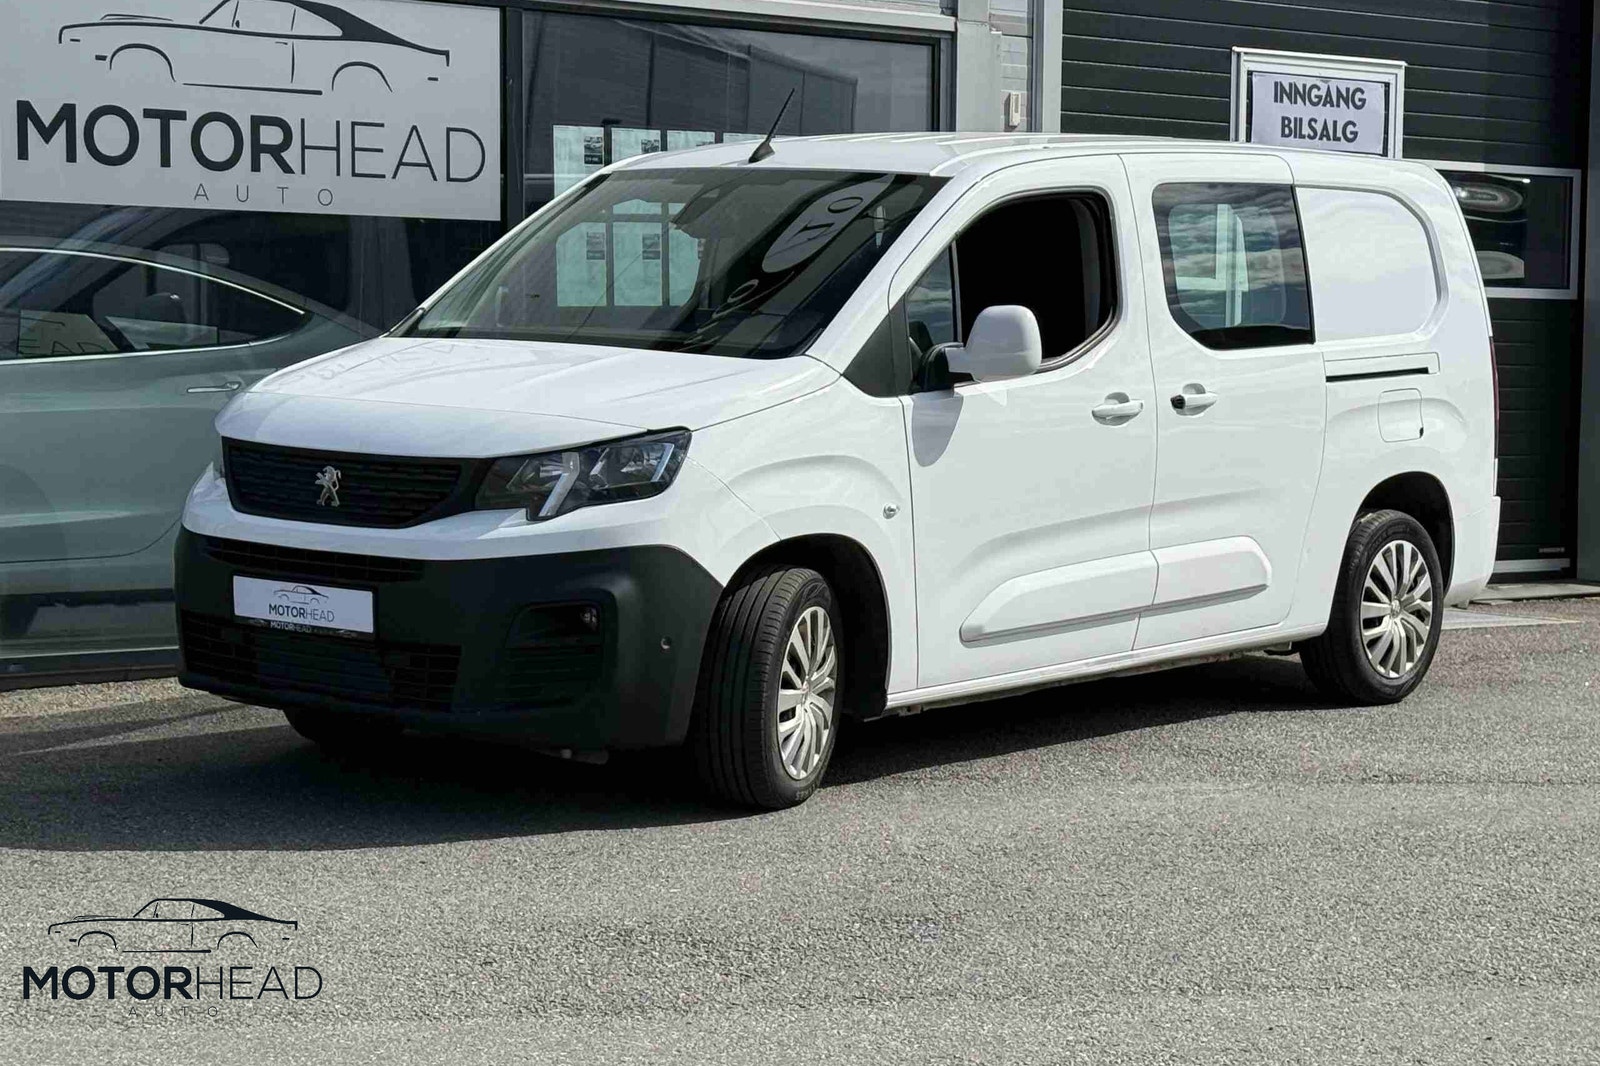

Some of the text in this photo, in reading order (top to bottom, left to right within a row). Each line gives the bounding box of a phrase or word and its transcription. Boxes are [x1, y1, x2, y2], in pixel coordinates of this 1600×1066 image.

[1273, 81, 1367, 110] INNGANG
[16, 100, 487, 183] MOTORHEAD
[1280, 115, 1359, 143] BILSALG
[193, 183, 334, 207] AUTO
[268, 603, 335, 623] MOTORHEAD
[270, 620, 313, 633] MOTORHEAD
